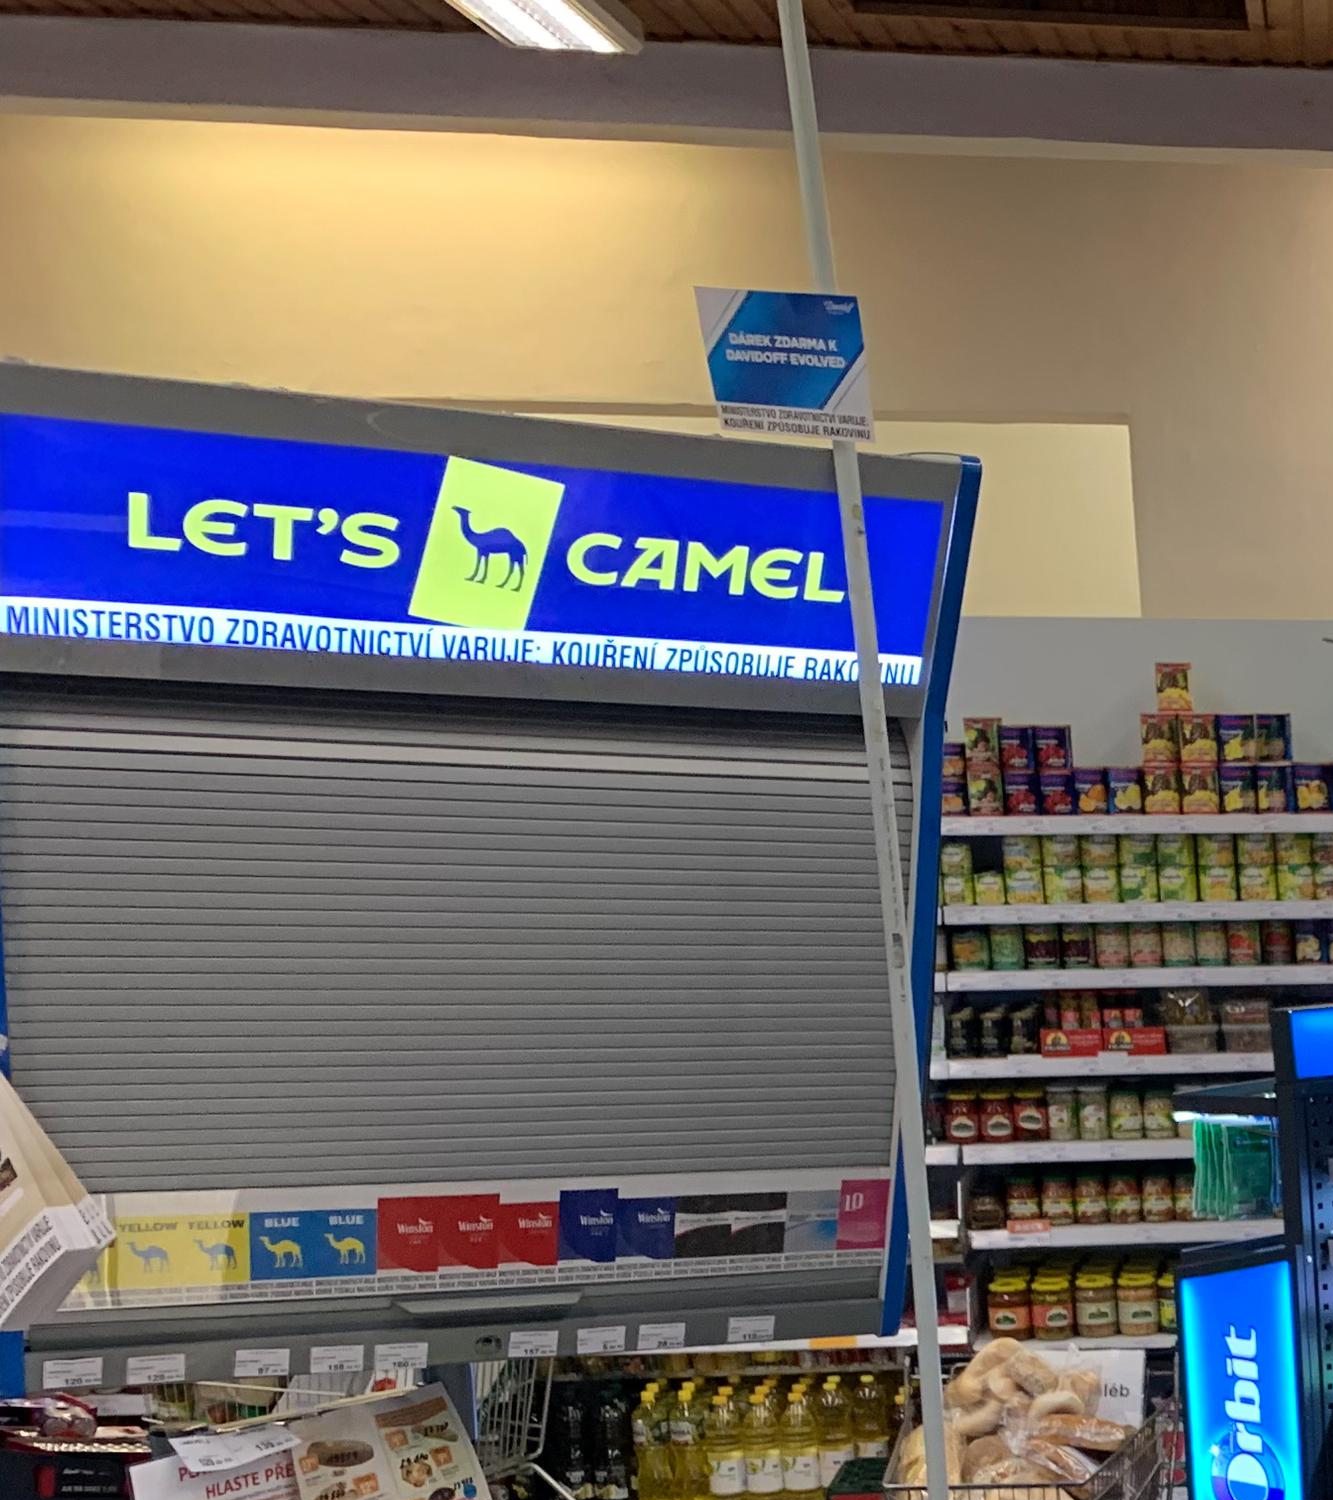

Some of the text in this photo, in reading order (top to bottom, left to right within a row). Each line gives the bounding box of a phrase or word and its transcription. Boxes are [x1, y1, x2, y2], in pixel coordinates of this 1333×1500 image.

[728, 331, 838, 352] DÁREK ZDARMA K
[726, 349, 846, 369] DAVIDOFF EVOLVED
[823, 426, 870, 440] RAKOVINU
[128, 491, 845, 603] LET'S CAMEL
[6, 605, 215, 644] MINISTERSTVO
[226, 616, 433, 660] ZDRAVOTNICTVÍ
[442, 629, 541, 665] VARUJE:
[552, 639, 657, 671] KOUŘENÍ
[665, 643, 795, 681] ZPŮSOBUJE
[264, 1214, 364, 1229] BLUE BLUE
[205, 1472, 261, 1499] HLASTE
